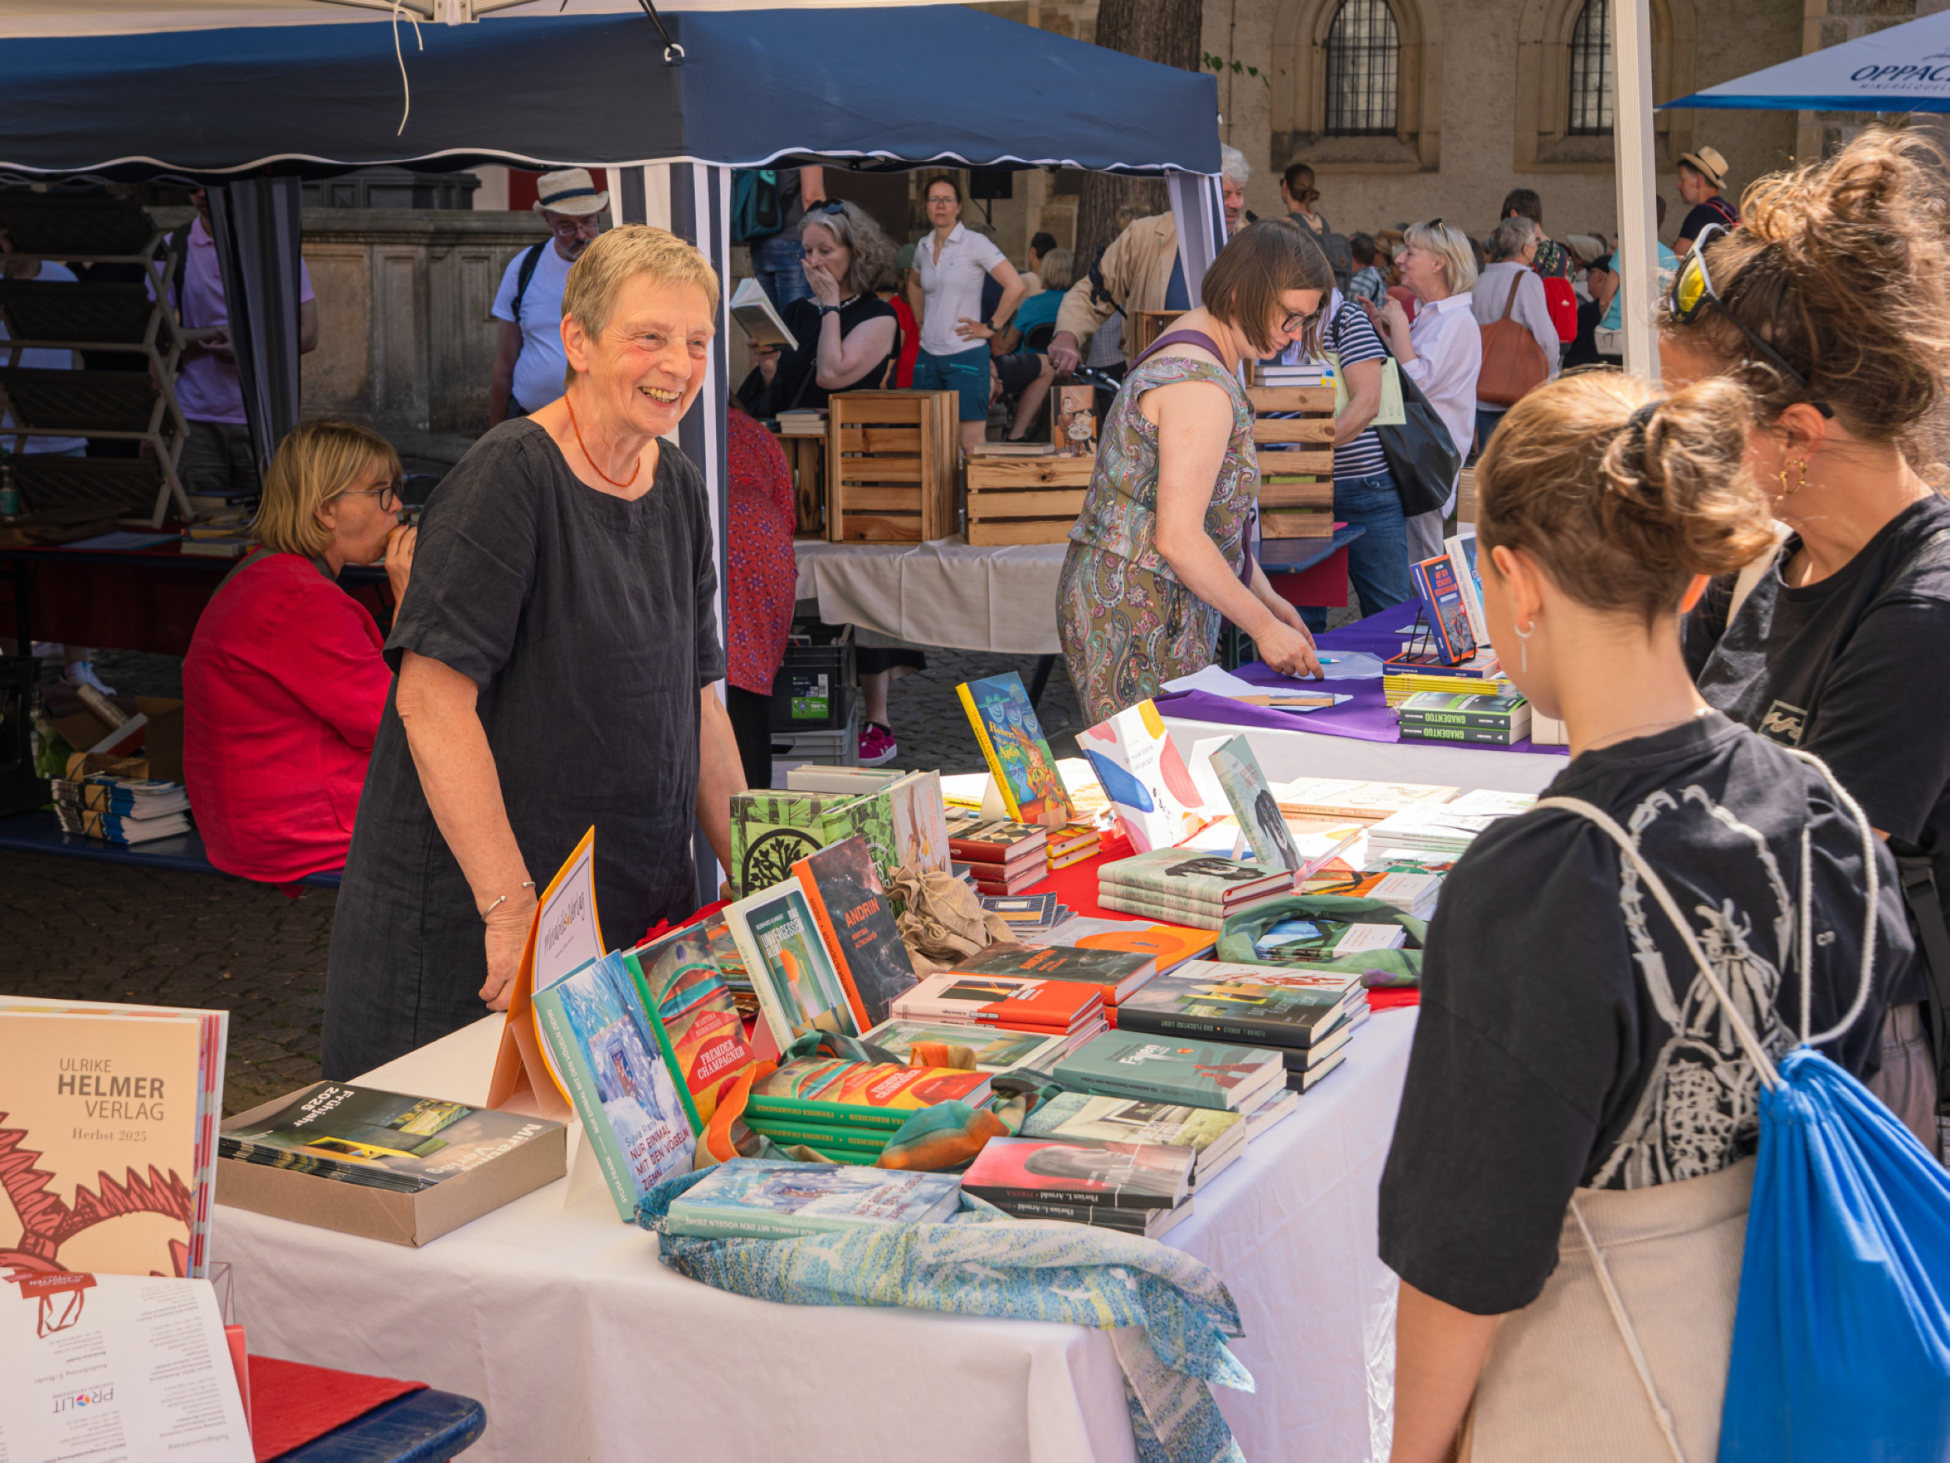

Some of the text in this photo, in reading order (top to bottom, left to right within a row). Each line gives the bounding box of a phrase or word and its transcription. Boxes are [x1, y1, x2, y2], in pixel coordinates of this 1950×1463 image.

[1850, 65, 1950, 81] OPPAC
[1424, 712, 1466, 725] GNADENTOD
[1422, 728, 1465, 741] GNADENTOD
[846, 897, 880, 928] ANDRIN
[700, 1039, 735, 1064] FREMDER
[59, 1058, 112, 1074] ULRIKE
[697, 1046, 745, 1080] CHAMPAGNER
[58, 1074, 164, 1099] HELMER
[85, 1100, 164, 1121] VERLAG
[292, 1089, 355, 1128] Frühjahr
[72, 1127, 148, 1143] Herbst 2025
[630, 1125, 670, 1160] NUR EINMAL
[636, 1127, 689, 1176] MIT DEN VÖGELN
[1040, 1192, 1064, 1200] Arnold
[1074, 1193, 1099, 1202] Florian
[1017, 1203, 1040, 1212] Arnold
[1050, 1206, 1074, 1216] Florian
[709, 1218, 738, 1231] VÖGELN
[739, 1222, 756, 1231] DEN
[757, 1224, 770, 1232] MIT
[772, 1225, 798, 1234] EINMAL
[52, 1387, 114, 1414] PROLIT
